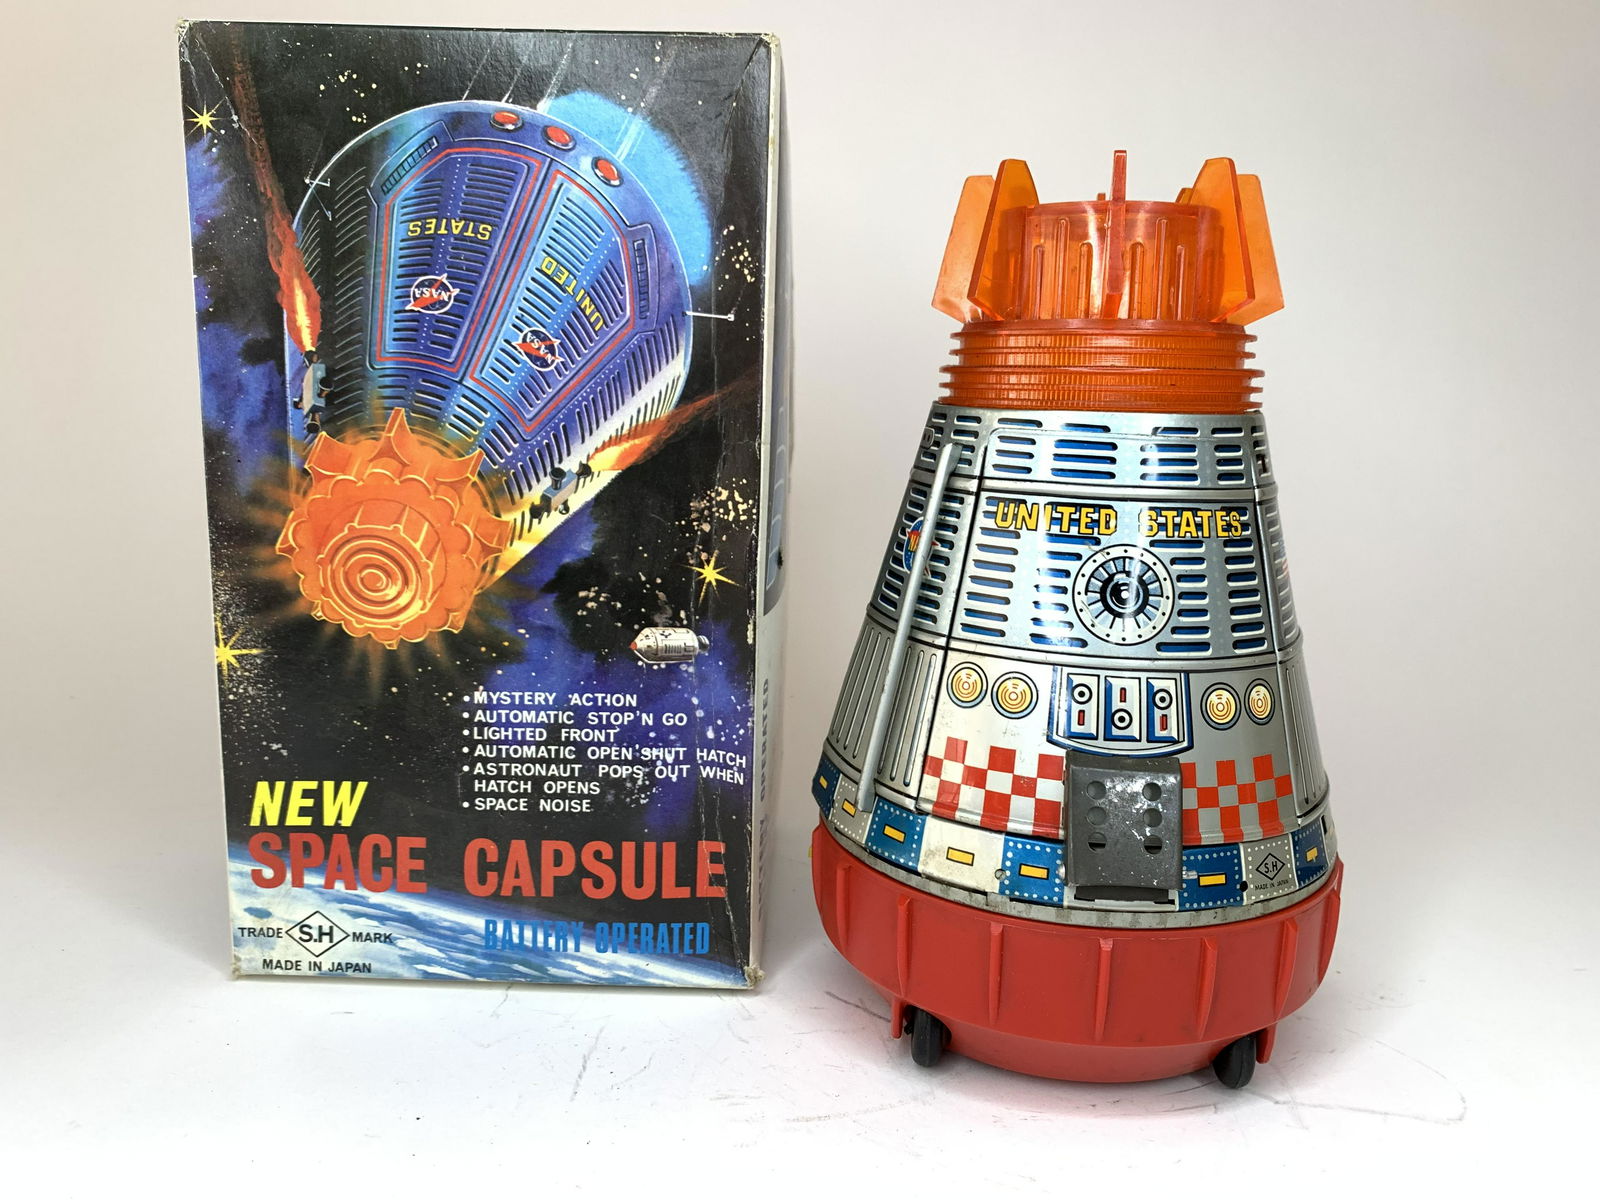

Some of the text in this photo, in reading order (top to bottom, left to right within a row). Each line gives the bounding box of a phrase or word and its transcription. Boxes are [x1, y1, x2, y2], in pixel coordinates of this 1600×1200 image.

[407, 217, 493, 241] STATES
[413, 287, 449, 302] NASA
[540, 256, 606, 331] UNITED
[994, 501, 1242, 538] UNITED STATES
[474, 691, 637, 707] MYSTERY ACTION
[474, 709, 574, 724] AUTOMATIC
[662, 713, 688, 726] GO
[473, 726, 617, 742] LIGHTED FRONT
[474, 745, 576, 759] AUTOMATIC
[696, 748, 746, 768] HATCH
[473, 763, 744, 785] ASTRONAUT POPS OUT WHEN
[474, 780, 600, 794] HATCH OPENS
[249, 780, 368, 827] NEW
[474, 798, 591, 812] SPACE NOISE
[248, 832, 727, 901] SPACE CAPSULE
[1263, 861, 1278, 874] S.H
[1254, 883, 1268, 891] MADE
[1276, 879, 1289, 887] JAPAN
[238, 924, 394, 944] TRADE S.H MARK
[484, 919, 710, 955] BATTERY OPERATED
[262, 959, 372, 973] MADE IN JAPAN
